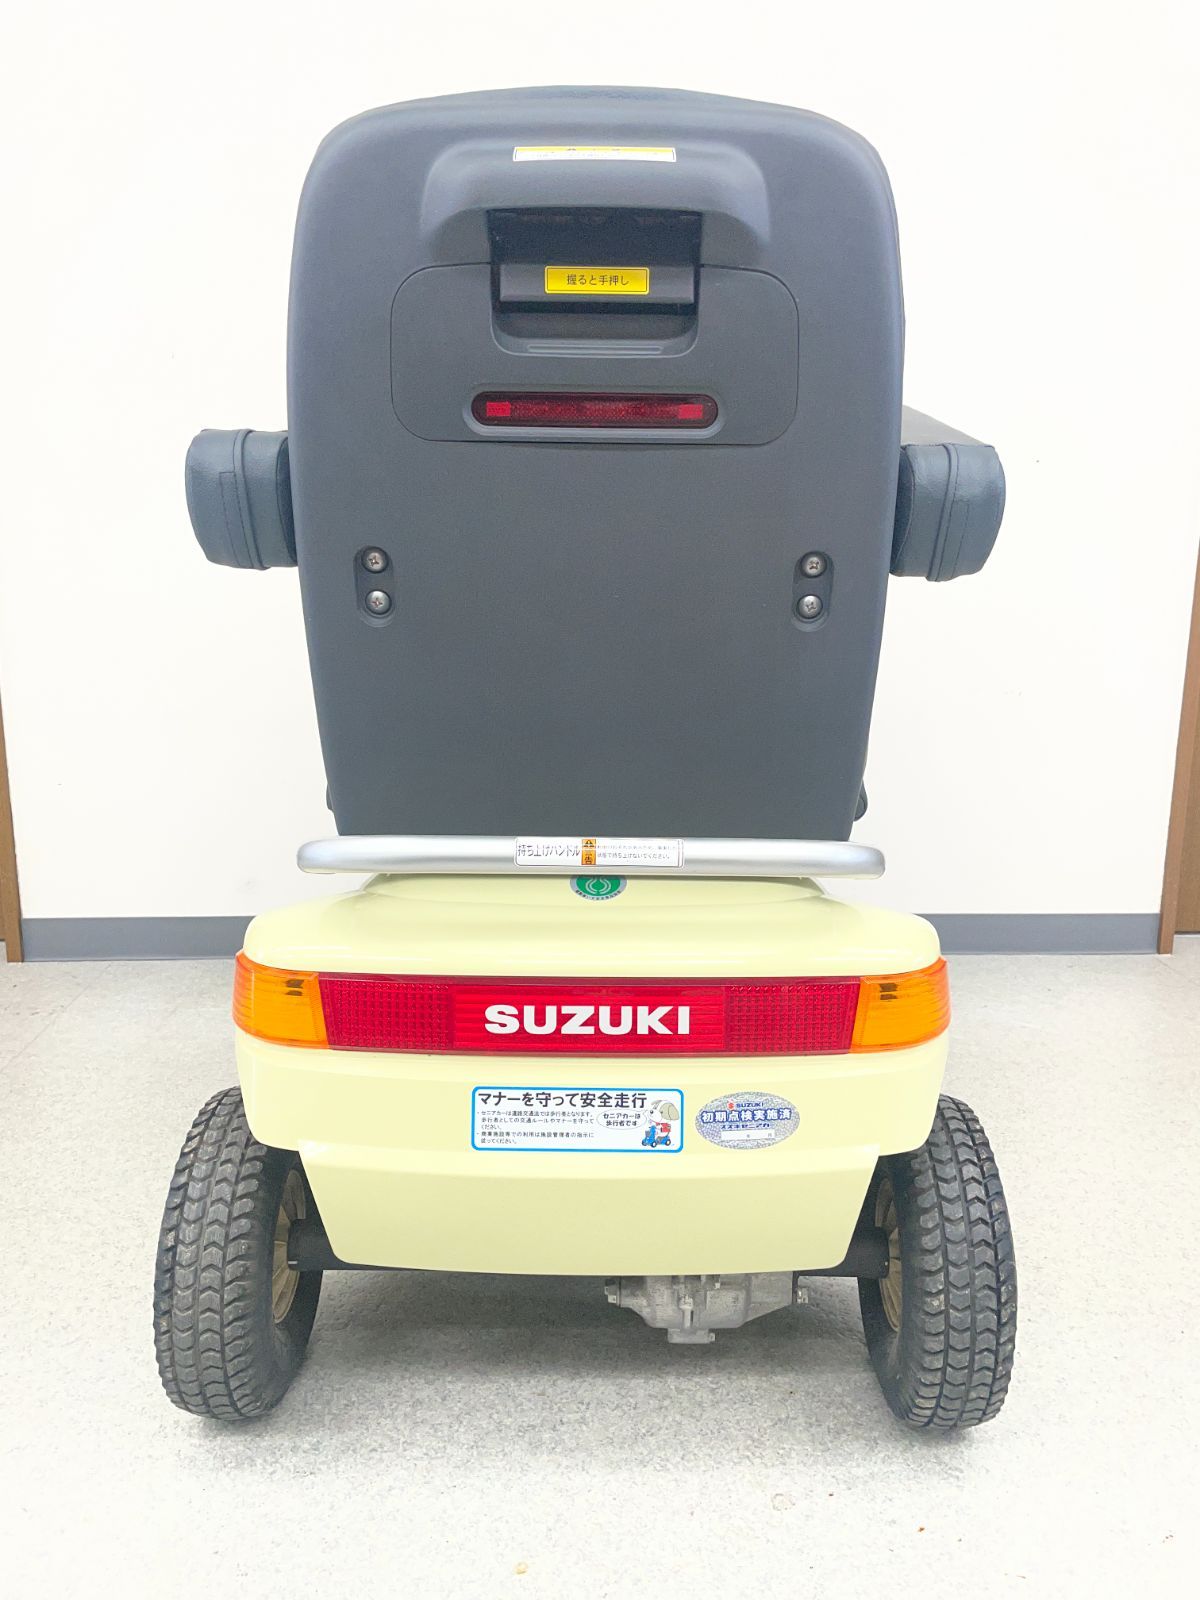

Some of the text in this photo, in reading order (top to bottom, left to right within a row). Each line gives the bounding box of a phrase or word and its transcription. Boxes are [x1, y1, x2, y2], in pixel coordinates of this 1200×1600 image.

[567, 274, 629, 286] 握ると手押し
[484, 1004, 690, 1035] SUZUKI
[478, 1092, 647, 1108] マナーを守って安全走行
[701, 1108, 792, 1123] 初期点検実施済
